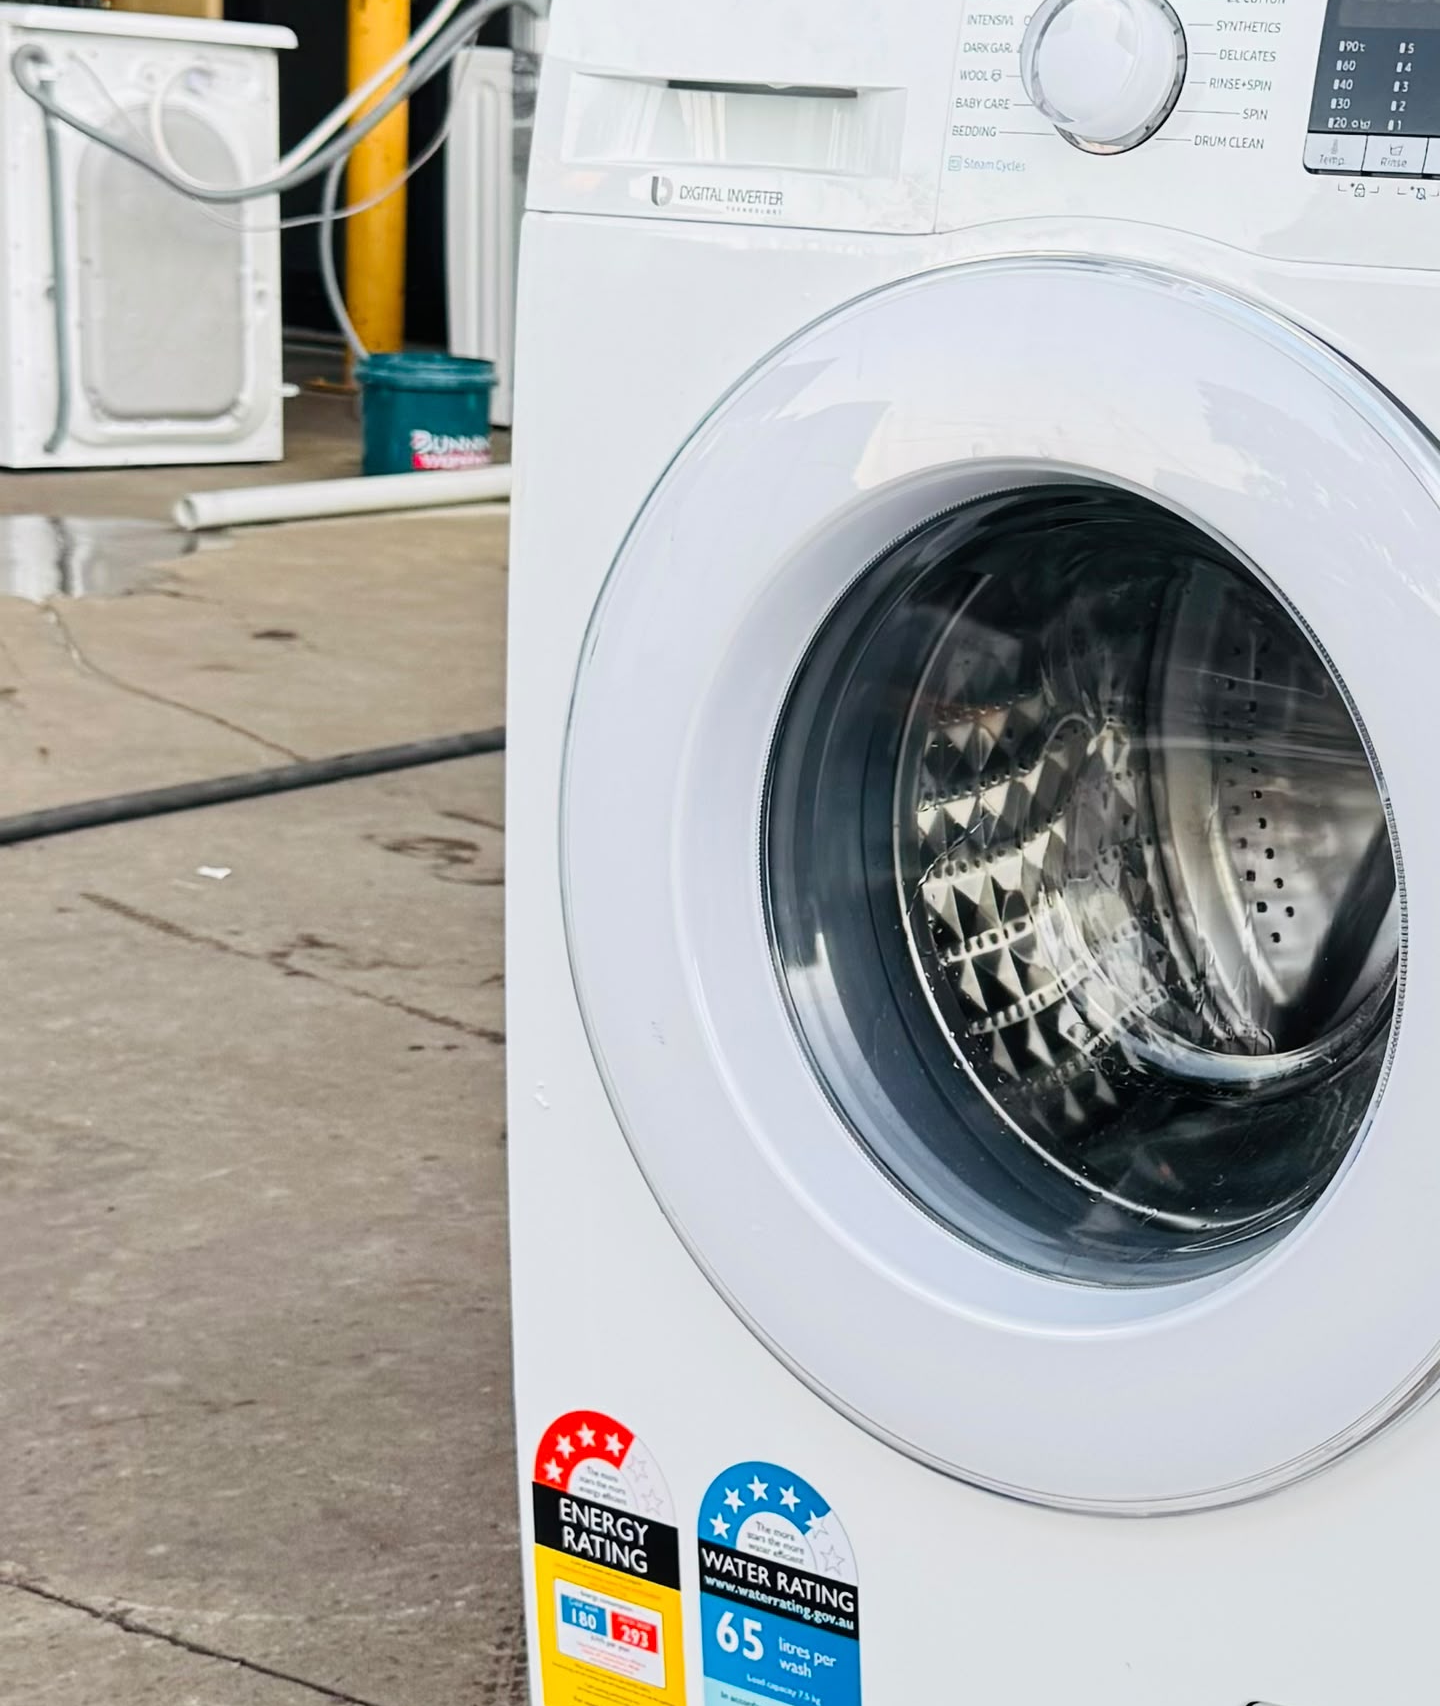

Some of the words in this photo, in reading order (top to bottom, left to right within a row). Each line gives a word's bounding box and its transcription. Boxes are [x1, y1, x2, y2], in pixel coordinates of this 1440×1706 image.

[1216, 20, 1281, 33] SYNTHETICS
[1407, 43, 1415, 54] 5
[1219, 49, 1276, 62] DELICATES
[1342, 60, 1356, 71] 60
[1404, 62, 1412, 72] 4
[960, 69, 988, 81] WOOL
[1339, 79, 1353, 90] 40
[1402, 81, 1409, 92] 3
[955, 97, 982, 109] BABY
[984, 98, 1011, 110] CARE
[1337, 98, 1351, 109] 30
[1399, 101, 1406, 112] 2
[1242, 108, 1268, 121] SPIN
[1334, 117, 1347, 129] 20
[952, 125, 997, 137] BEDDING
[1194, 134, 1227, 147] DRUM
[1229, 136, 1264, 150] CLEAN
[963, 158, 994, 170] Steam
[996, 160, 1026, 173] Cycles
[1380, 157, 1407, 168] Rinse
[679, 185, 724, 202] DIGITAL
[727, 188, 784, 206] INVERTER
[559, 1497, 649, 1546] ENERGY
[756, 1521, 771, 1534] The
[562, 1525, 648, 1574] RATING
[702, 1547, 772, 1588] WATER
[776, 1571, 854, 1613] RATING
[704, 1575, 854, 1630] www.waterrating.gov.au
[572, 1608, 596, 1630] 180
[620, 1625, 649, 1648] 293
[716, 1610, 764, 1661] 65
[778, 1636, 811, 1660] litres
[814, 1652, 837, 1667] per
[779, 1658, 812, 1678] wash
